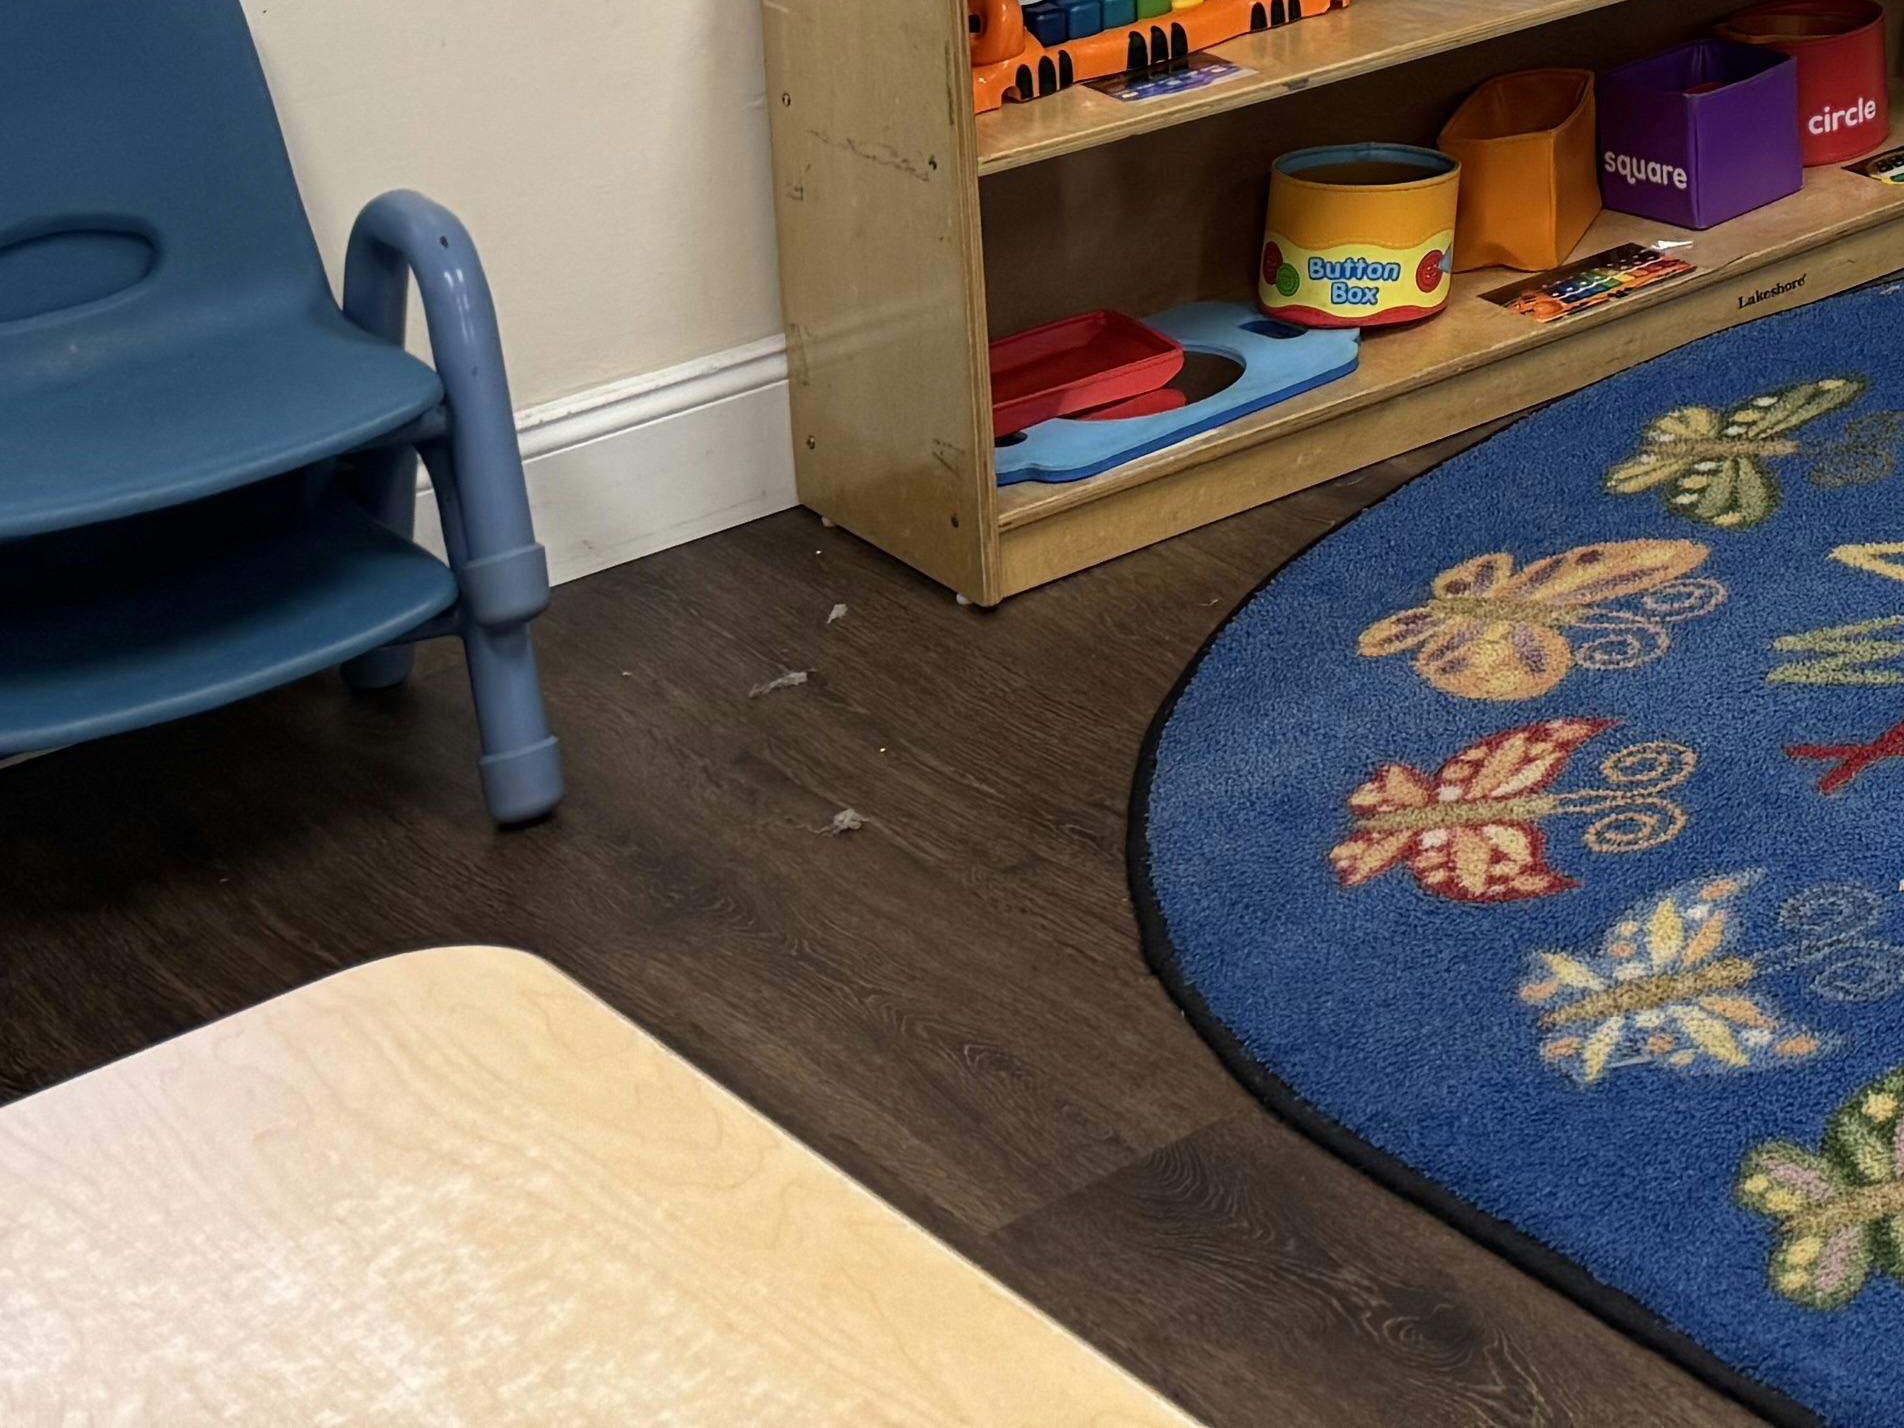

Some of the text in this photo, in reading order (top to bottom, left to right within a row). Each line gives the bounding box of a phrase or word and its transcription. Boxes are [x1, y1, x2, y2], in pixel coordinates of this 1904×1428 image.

[1809, 98, 1876, 135] circle
[1604, 150, 1687, 190] square
[1309, 256, 1400, 283] Button
[1331, 280, 1379, 305] Box
[1738, 273, 1806, 311] Lakeshore
